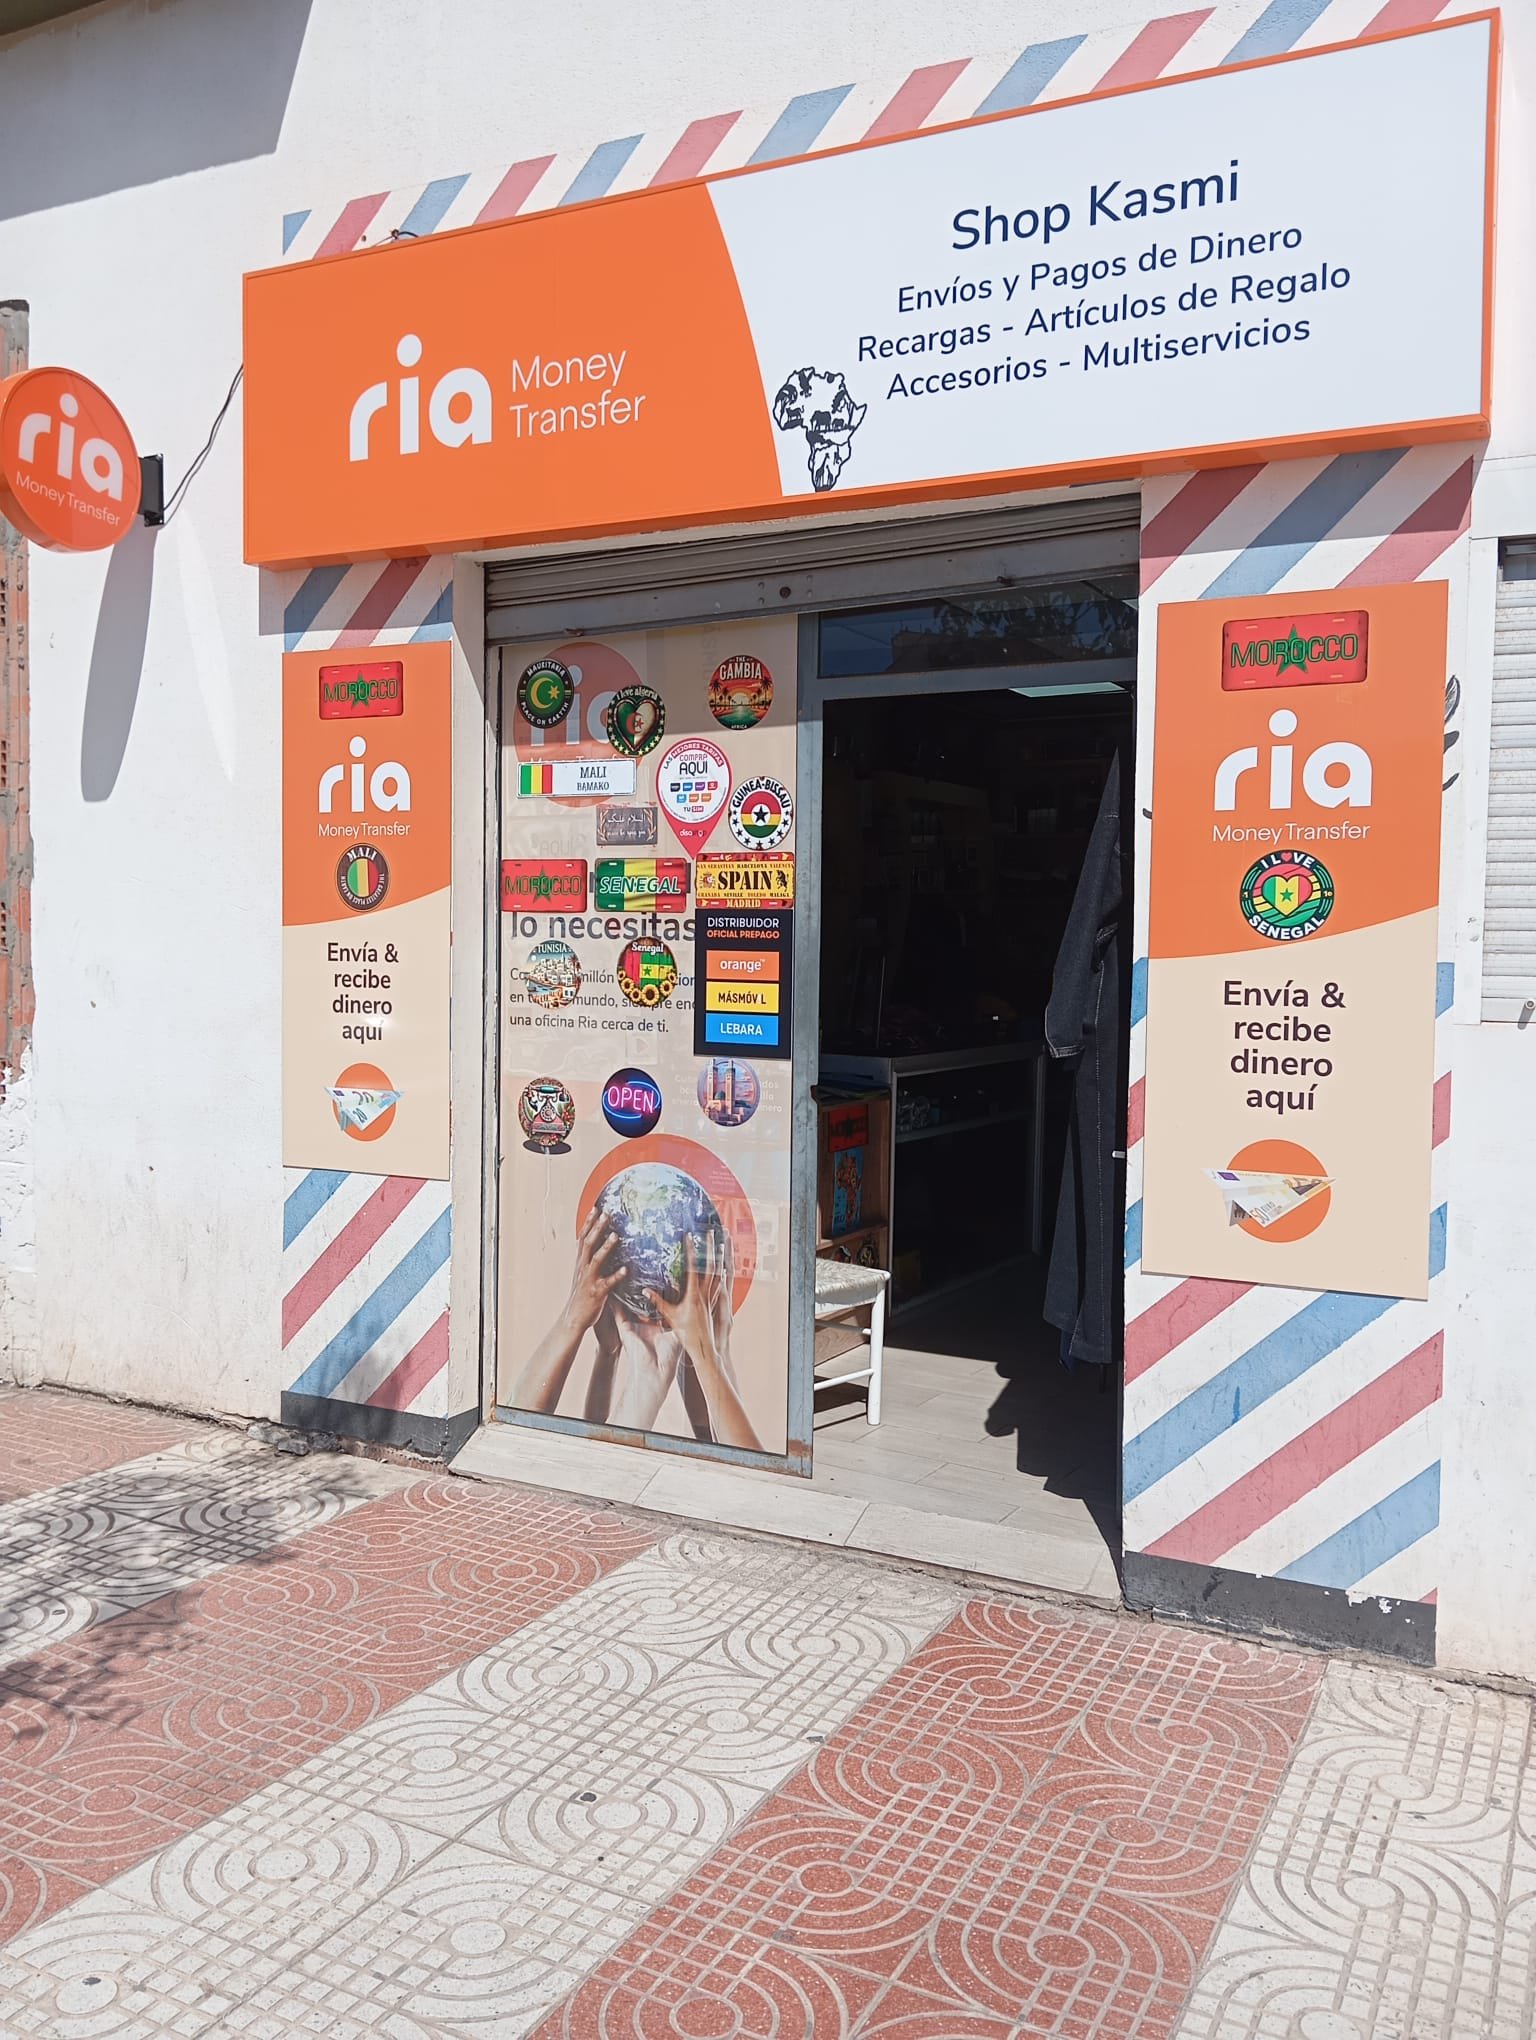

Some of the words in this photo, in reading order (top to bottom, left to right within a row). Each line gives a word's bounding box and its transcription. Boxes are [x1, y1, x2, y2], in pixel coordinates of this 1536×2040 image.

[952, 196, 1071, 250] Shop
[1088, 160, 1239, 226] Kasmi
[897, 270, 993, 314] Envíos
[1002, 272, 1020, 301] y
[1030, 252, 1126, 293] Pagos
[1137, 241, 1178, 276] de
[1189, 224, 1303, 264] Dinero
[857, 319, 991, 363] Recargas
[1024, 291, 1166, 338] Artículos
[1177, 281, 1218, 315] de
[1231, 262, 1351, 308] Regalo
[886, 357, 1047, 400] Accesorios
[1082, 315, 1311, 372] Multiservicios
[512, 349, 628, 392] Money
[348, 334, 493, 462] ria
[511, 391, 646, 438] Transfer
[18, 393, 124, 502] ria
[16, 471, 65, 506] Money
[67, 492, 121, 526] Transfer
[1231, 633, 1358, 668] MOROCCO
[719, 662, 762, 680] GAMBIA
[324, 679, 398, 703] MOROCCO
[1214, 708, 1373, 811] ria
[318, 735, 411, 813] ria
[580, 766, 607, 779] MALI
[577, 782, 610, 792] BAMAKO
[732, 779, 791, 808] GUINEA-BISSAU
[318, 823, 360, 840] Money
[361, 820, 411, 837] Transfer
[1213, 825, 1282, 845] Money
[1284, 820, 1370, 841] Transfer
[347, 847, 377, 862] MALI
[1260, 859, 1269, 868] I
[505, 875, 583, 896] MOROCCO
[599, 876, 682, 895] SENEGAL
[718, 871, 774, 890] SPAIN
[726, 899, 761, 908] MADRID
[706, 929, 738, 938] OFICIAL
[740, 930, 780, 939] PREPAGO
[707, 917, 780, 928] DISTRIBUIDOR
[1249, 914, 1325, 940] SENEGAL
[327, 941, 378, 962] Envía
[385, 943, 399, 963] &
[537, 945, 567, 953] TUNISIA
[631, 942, 664, 955] Senegal
[720, 959, 762, 973] orange
[334, 969, 391, 989] recibe
[332, 994, 393, 1015] dinero
[510, 992, 524, 1003] en
[1224, 980, 1309, 1008] Envía
[1321, 982, 1346, 1009] &
[342, 1020, 384, 1044] aquí
[510, 1016, 531, 1026] una
[535, 1014, 574, 1028] oficina
[578, 1015, 598, 1028] Ria
[601, 1019, 633, 1030] cerca
[637, 1017, 653, 1031] de
[656, 1018, 669, 1033] ti.
[720, 1023, 763, 1036] LEBARA
[1234, 1016, 1331, 1042] recibe
[1230, 1048, 1333, 1077] dinero
[606, 1085, 655, 1114] OPEN
[1246, 1084, 1318, 1115] aquí
